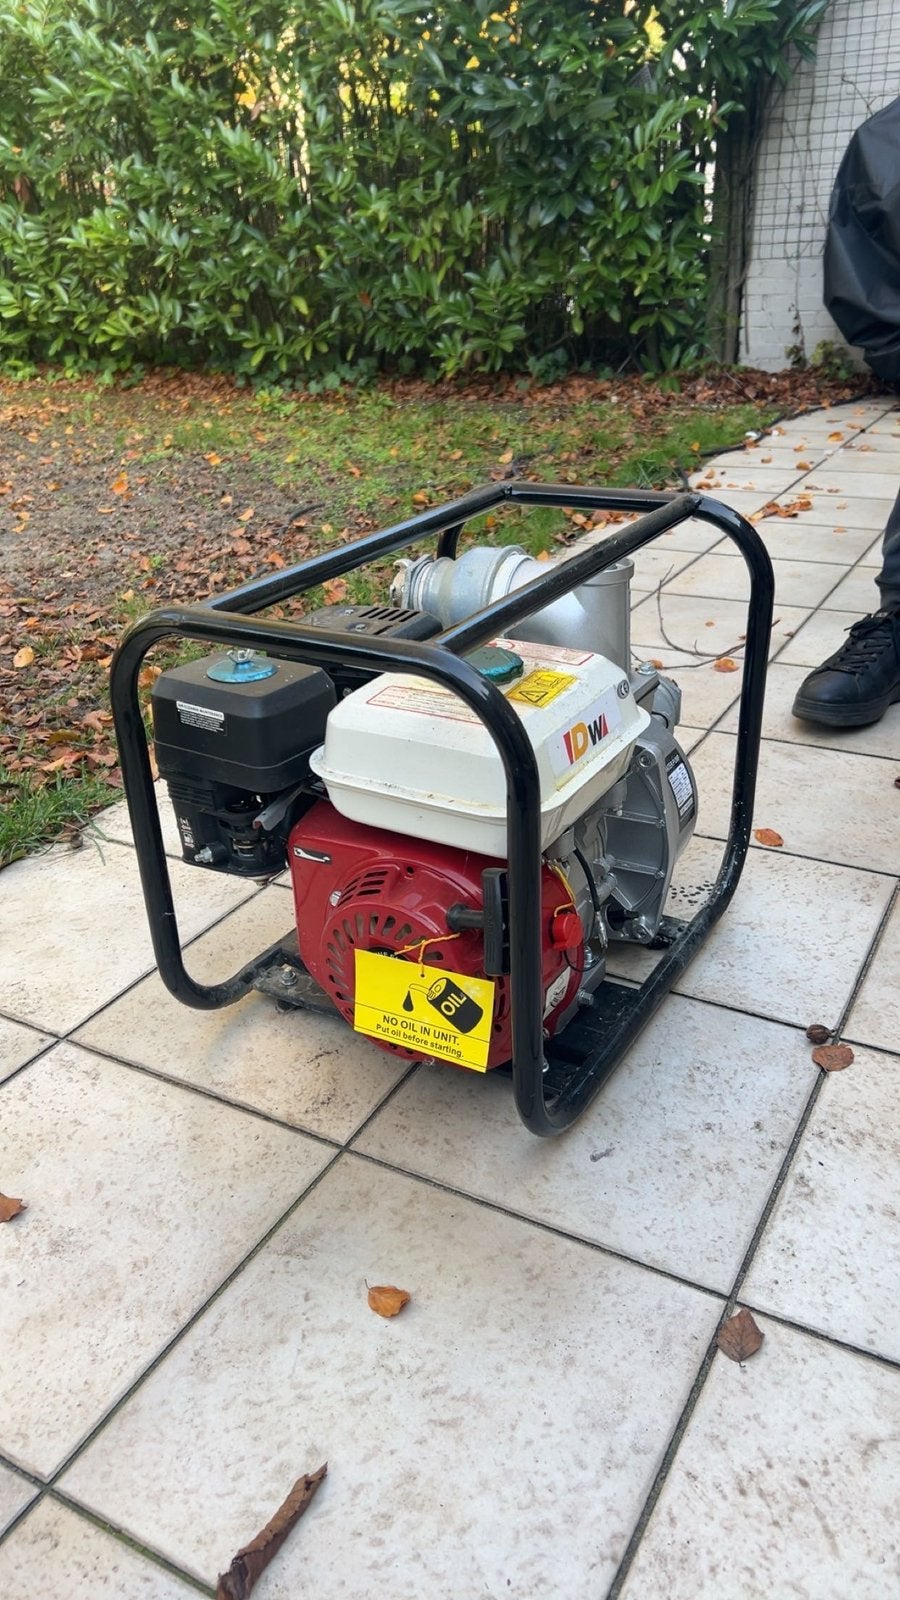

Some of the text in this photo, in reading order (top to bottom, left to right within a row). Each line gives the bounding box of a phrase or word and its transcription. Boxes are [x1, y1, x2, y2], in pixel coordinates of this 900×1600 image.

[440, 993, 467, 1016] OIL
[376, 1024, 464, 1058] Put oil before starting.
[382, 1015, 460, 1046] NO OIL IN UNIT.
